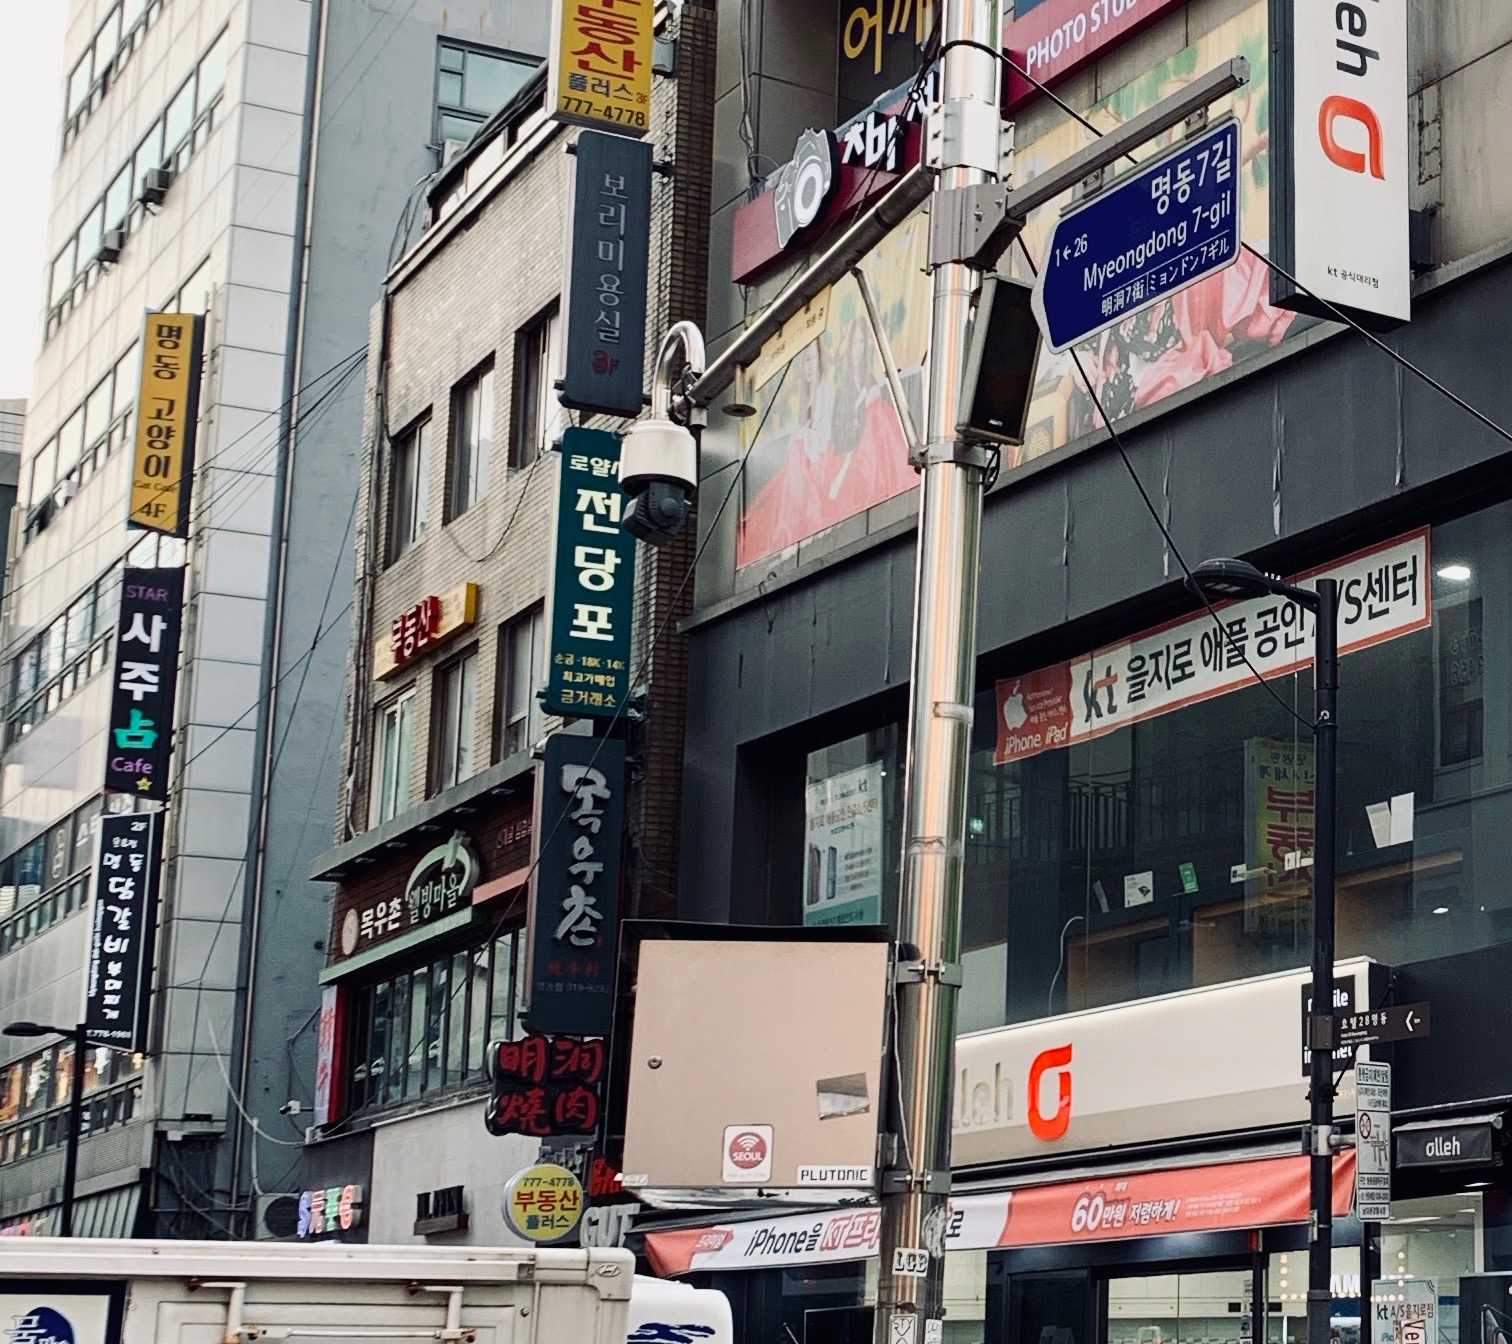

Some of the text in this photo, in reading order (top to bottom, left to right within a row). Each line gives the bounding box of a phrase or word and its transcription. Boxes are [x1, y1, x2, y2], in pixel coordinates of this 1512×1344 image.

[1026, 11, 1087, 75] PHOTO
[568, 72, 650, 105] 플러스 3F
[562, 95, 646, 128] 777-4778
[1152, 133, 1232, 216] 명동7길
[1073, 233, 1089, 259] 26
[1083, 189, 1232, 292] Myeongdong 7-gil
[595, 171, 630, 344] 보리미용실
[143, 323, 184, 479] 명동 고양이
[138, 501, 168, 519] 4F
[569, 488, 622, 643] 전당포
[124, 584, 169, 603] STAR
[1083, 664, 1119, 723] kt
[1126, 637, 1196, 704] 을지로
[1200, 616, 1249, 675] 애플
[1253, 601, 1306, 658] 공인
[1045, 722, 1069, 744] iPad
[110, 756, 154, 775] Cafe
[552, 763, 612, 947] 목우촌
[360, 872, 464, 940] 목우촌 웰빙마을
[500, 1035, 605, 1087] 明洞
[733, 1150, 763, 1162] SEOUL
[1425, 1136, 1461, 1157] olleh
[522, 1176, 575, 1188] 777-4778
[800, 1168, 868, 1182] PLUTONIC
[513, 1189, 579, 1213] 부동산
[1071, 1195, 1127, 1232] 60만원
[1129, 1199, 1182, 1226] 저렴하게!
[526, 1214, 571, 1231] 플러스
[744, 1217, 849, 1257] iPhone을 KT
[1376, 1304, 1389, 1321] kt
